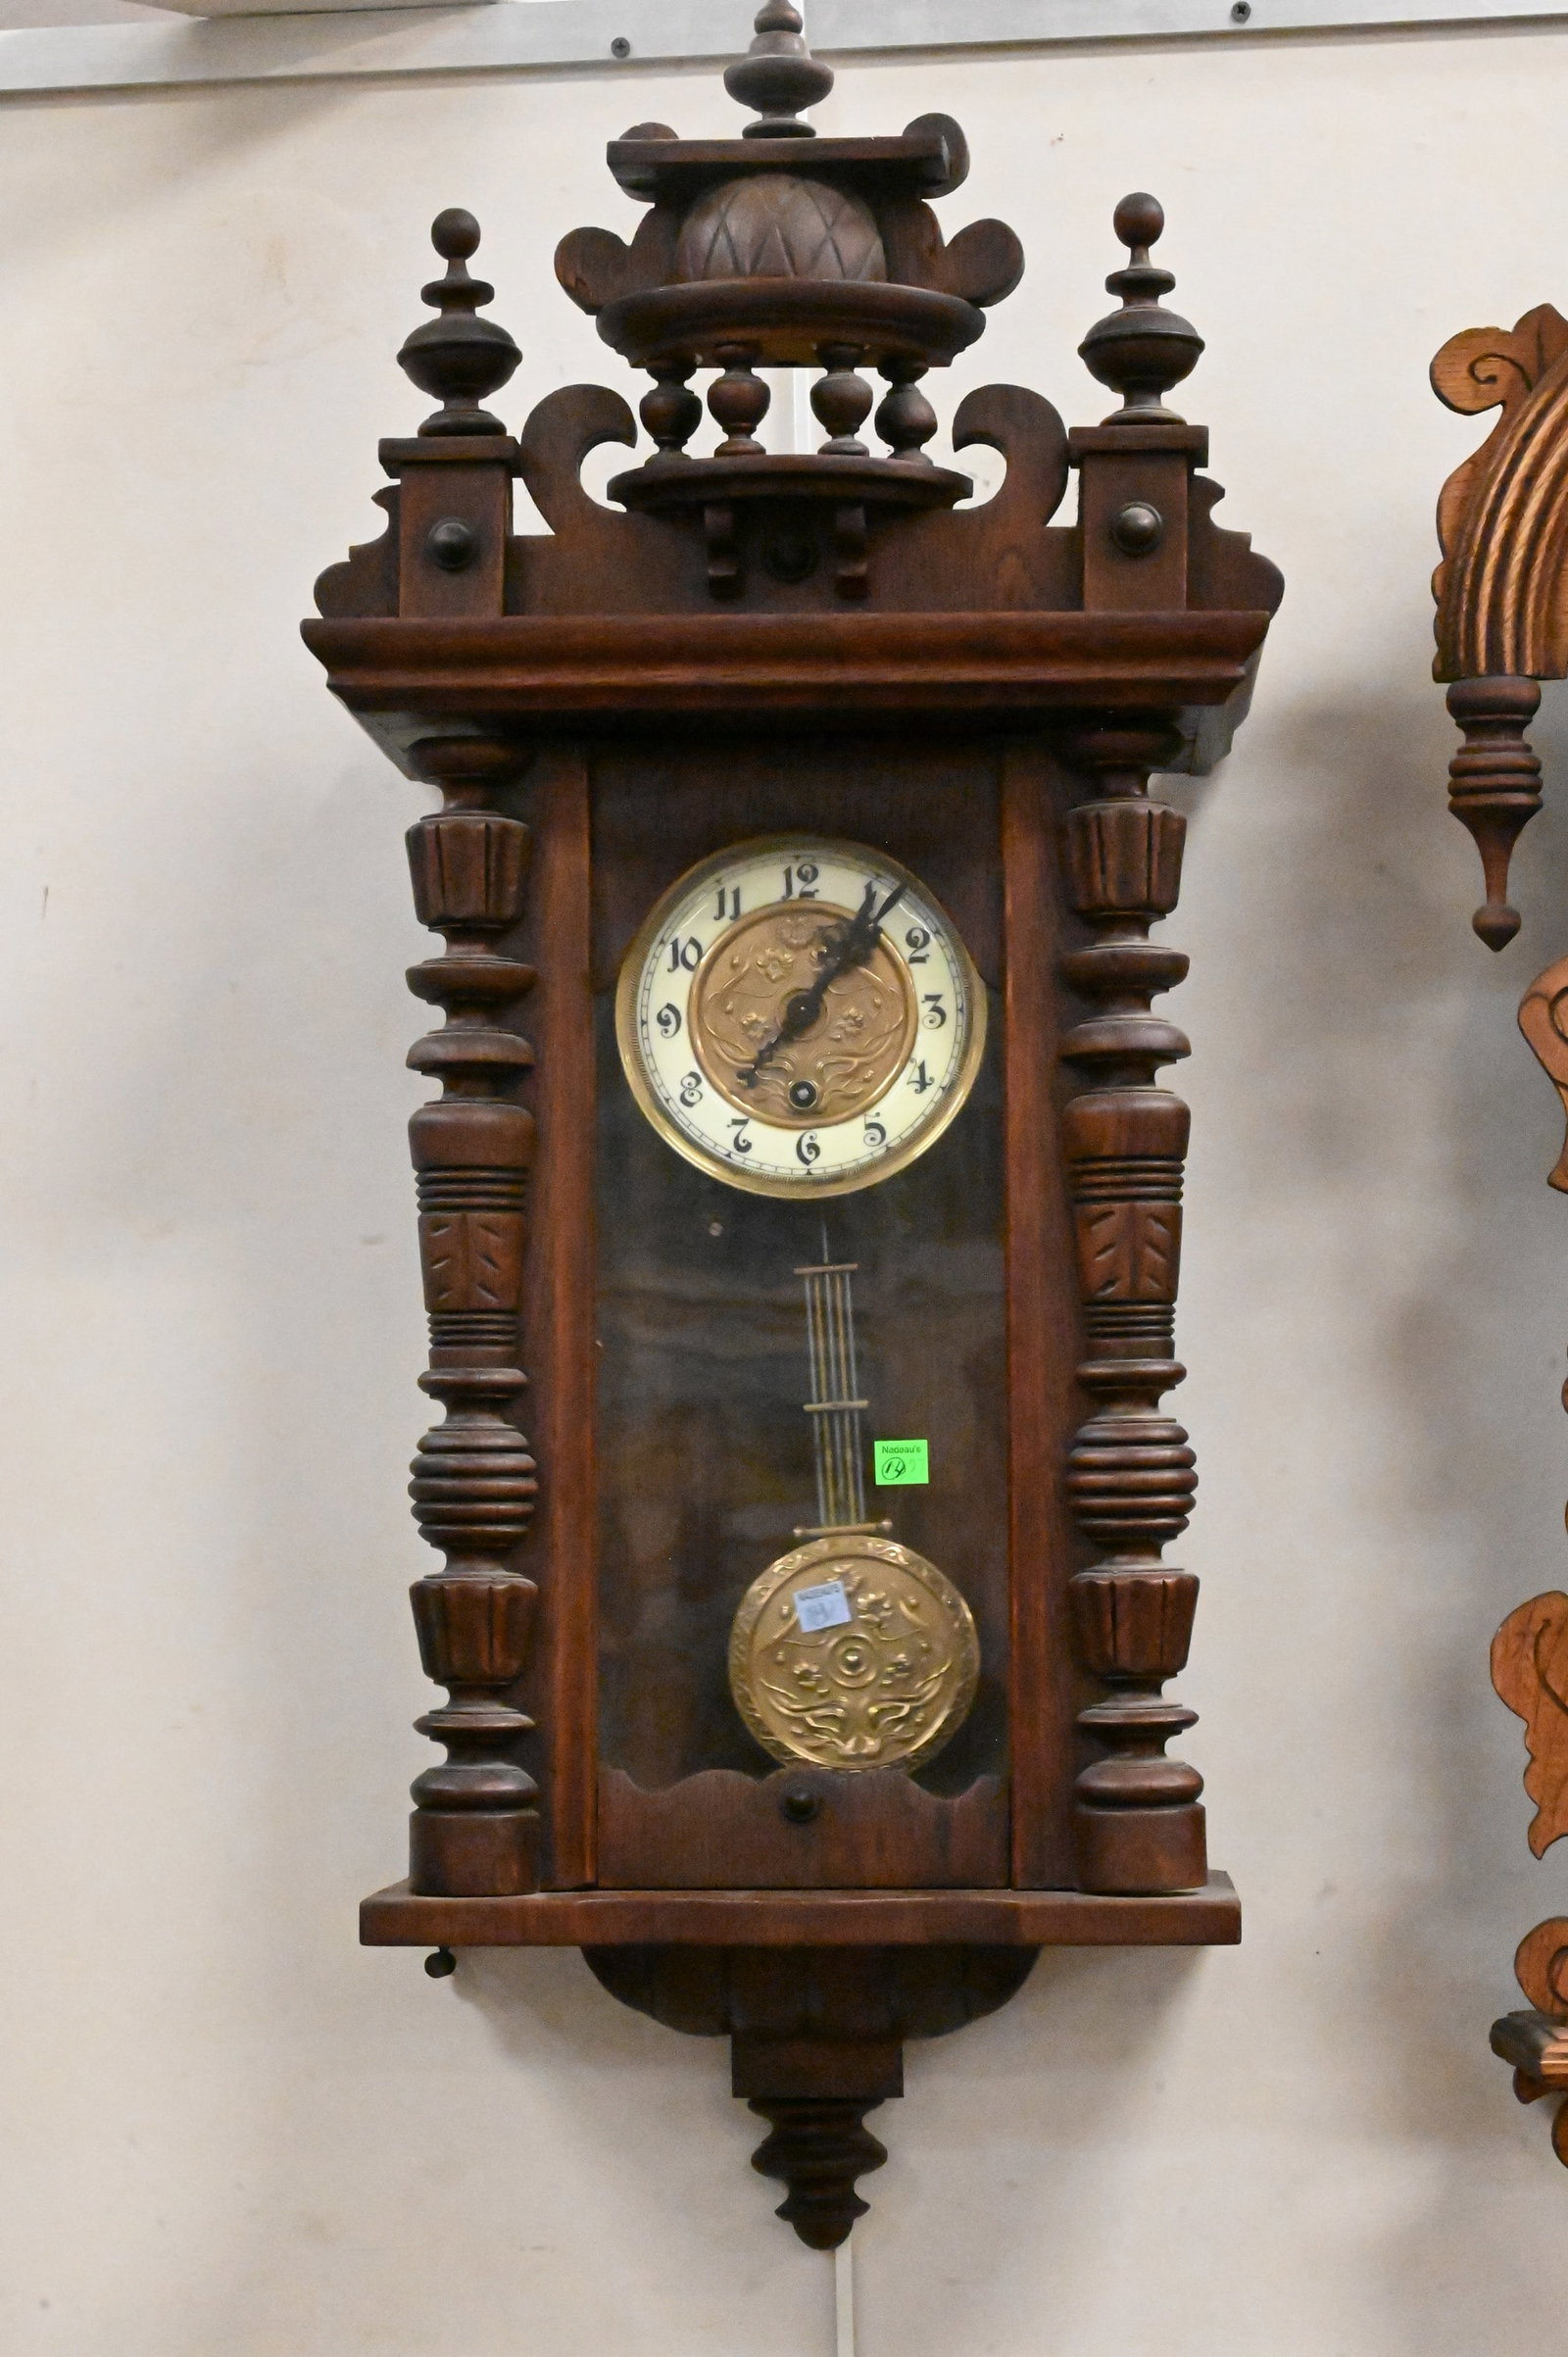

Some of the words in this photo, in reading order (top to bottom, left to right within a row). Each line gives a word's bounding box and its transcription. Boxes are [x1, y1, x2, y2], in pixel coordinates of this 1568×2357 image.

[781, 862, 820, 901] 12
[712, 886, 741, 921] 11
[666, 936, 704, 973] 10
[905, 926, 931, 964] 2
[657, 1003, 682, 1039] 9
[921, 994, 947, 1030] 3
[679, 1070, 704, 1107] 8
[906, 1057, 935, 1095] 4
[726, 1118, 753, 1154] 7
[863, 1111, 887, 1147] 5
[796, 1131, 821, 1166] 6
[882, 1445, 922, 1454] Nadeau's
